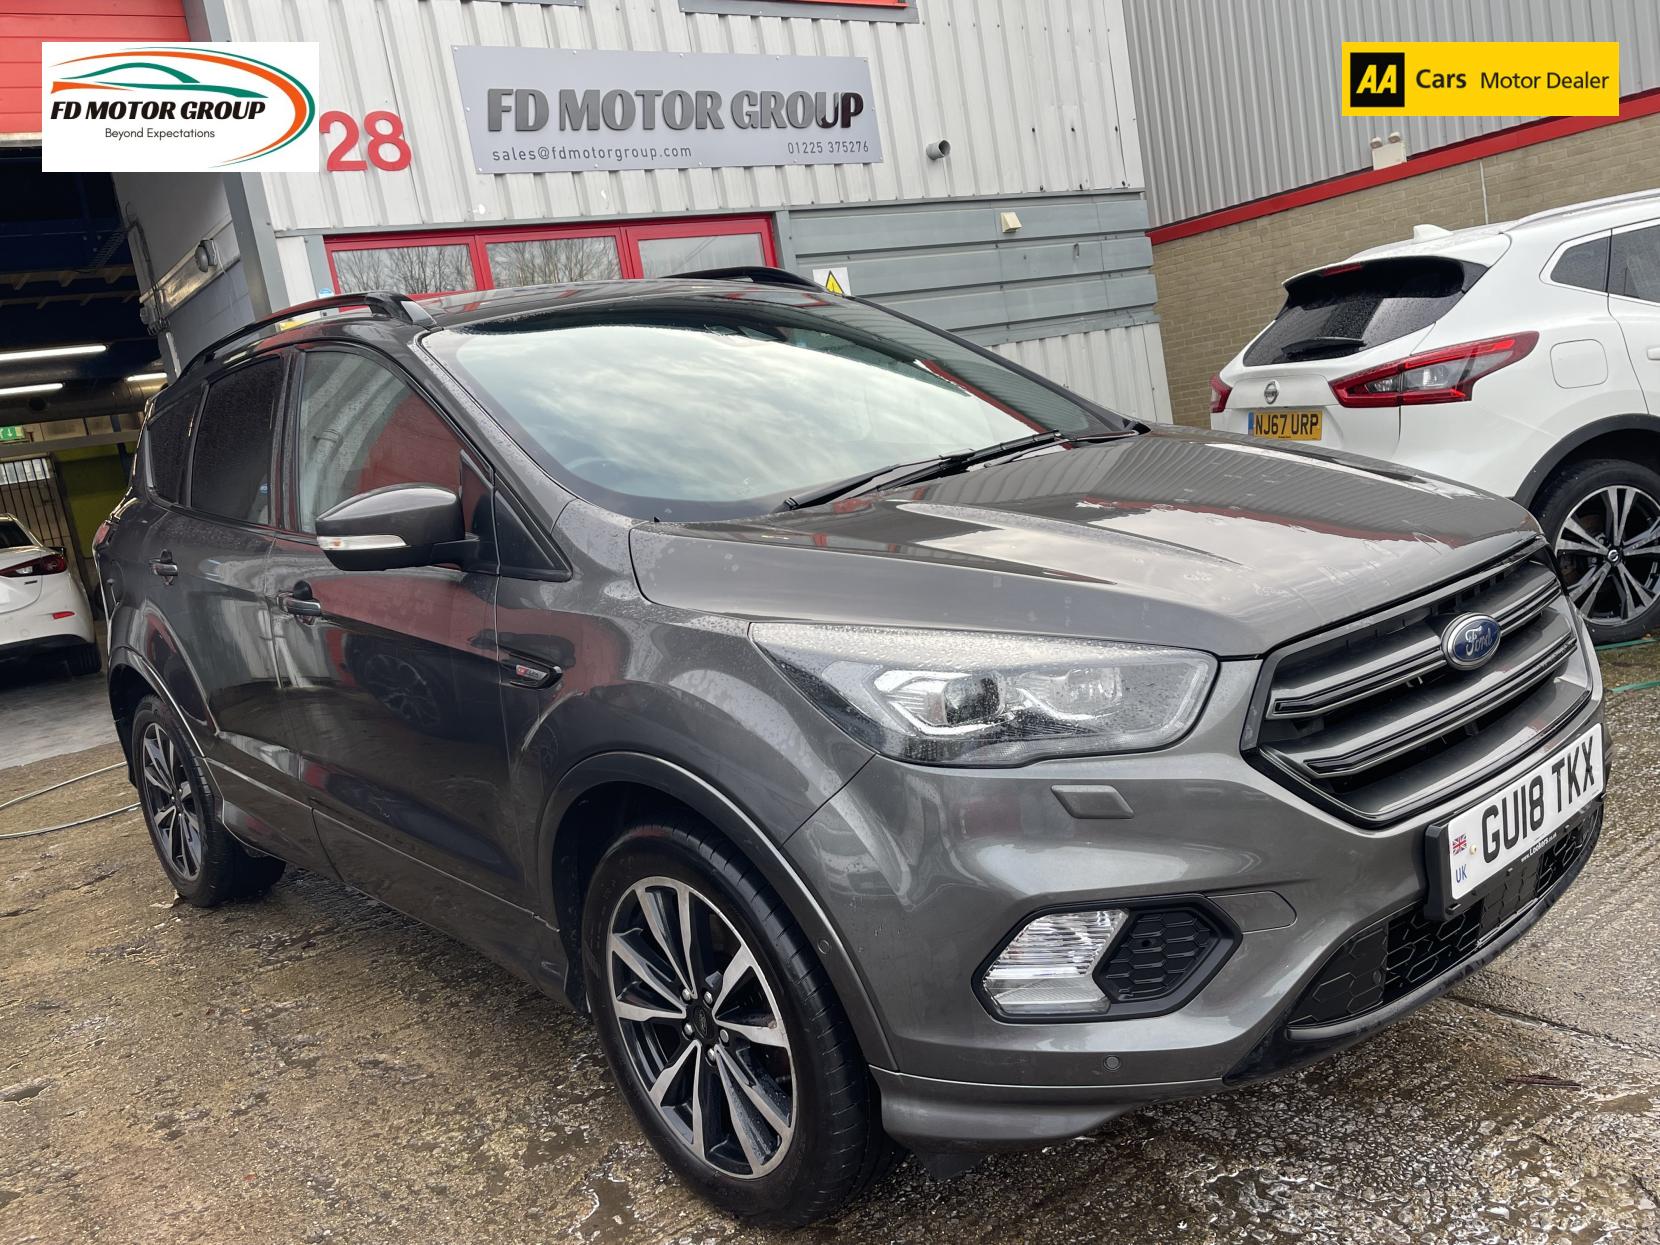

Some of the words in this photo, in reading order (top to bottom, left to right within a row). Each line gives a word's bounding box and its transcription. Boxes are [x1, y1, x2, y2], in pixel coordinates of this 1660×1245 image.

[487, 88, 549, 132] FD
[559, 89, 725, 131] MOTOR
[730, 90, 865, 130] GROUP
[319, 110, 412, 172] 28
[492, 144, 693, 162] sales@fdmotorgroup.com
[787, 140, 824, 155] 01225
[827, 140, 870, 154] 375276
[1255, 413, 1288, 436] NJ67
[1291, 413, 1319, 436] URP
[1464, 625, 1493, 656] Ford
[1481, 774, 1545, 864] GU18
[1551, 735, 1595, 814] TKX
[1455, 863, 1468, 884] UK
